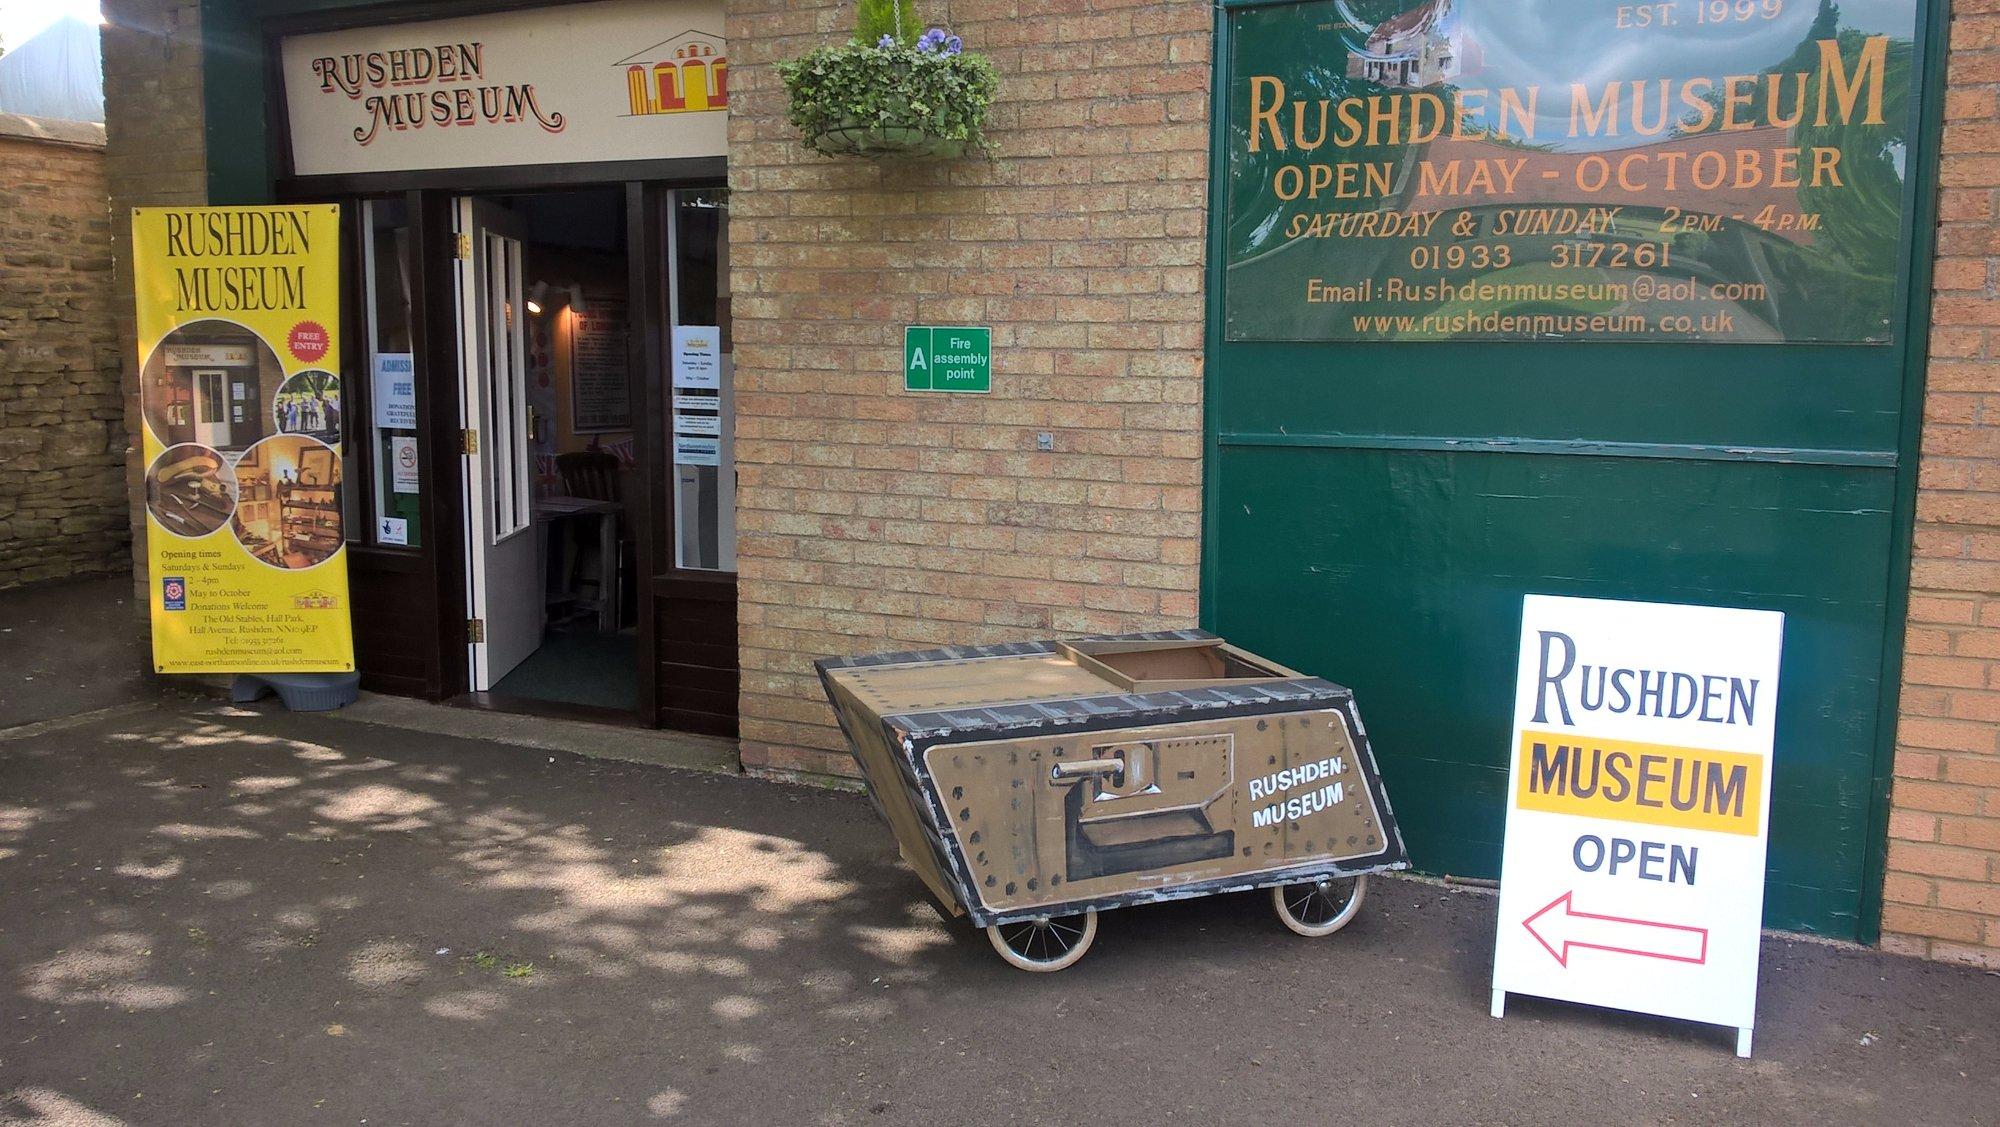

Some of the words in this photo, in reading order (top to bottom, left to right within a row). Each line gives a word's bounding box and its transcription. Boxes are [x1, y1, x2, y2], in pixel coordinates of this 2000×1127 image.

[1615, 3, 1678, 29] EST.
[1697, 0, 1783, 25] 1999
[312, 42, 485, 99] RUSHDEN
[1248, 76, 1540, 153] RUSHDEN
[1567, 36, 1889, 138] MUSEUM
[354, 83, 566, 146] MUSEUM
[1274, 162, 1394, 201] OPEN
[1417, 157, 1528, 197] MAY
[1575, 147, 1844, 192] OCTOBER
[165, 210, 310, 257] RUSHDEN
[1285, 209, 1444, 239] SATURDAY
[1451, 209, 1477, 237] &
[1492, 207, 1623, 236] SUNDAY
[1410, 244, 1512, 270] 01933
[1550, 241, 1672, 269] 317261
[175, 266, 307, 312] MUSEUM
[1353, 309, 1734, 334] www.rushdenmuseum.co.uk
[294, 341, 323, 350] ENTRY
[297, 332, 320, 340] FREE
[950, 337, 971, 349] Fire
[910, 347, 927, 370] A
[934, 353, 987, 367] assembly
[946, 368, 975, 381] point
[393, 382, 412, 396] FREE
[161, 550, 197, 560] Opening
[162, 563, 200, 572] Saturdays
[212, 562, 245, 572] Sundays
[189, 576, 194, 584] 2
[202, 576, 219, 585] 4pm
[189, 590, 207, 598] May
[219, 589, 250, 597] October
[191, 603, 230, 611] Donations
[233, 602, 268, 610] Welcome
[203, 615, 219, 623] The
[266, 614, 283, 622] Hall
[189, 626, 205, 634] Hall
[224, 636, 238, 644] Tel:
[1530, 630, 1760, 726] RUSHDEN
[1248, 756, 1342, 802] RUSHDEN
[1528, 742, 1748, 818] MUSEUM
[1252, 781, 1344, 828] MUSEUM
[1572, 834, 1699, 886] OPEN
